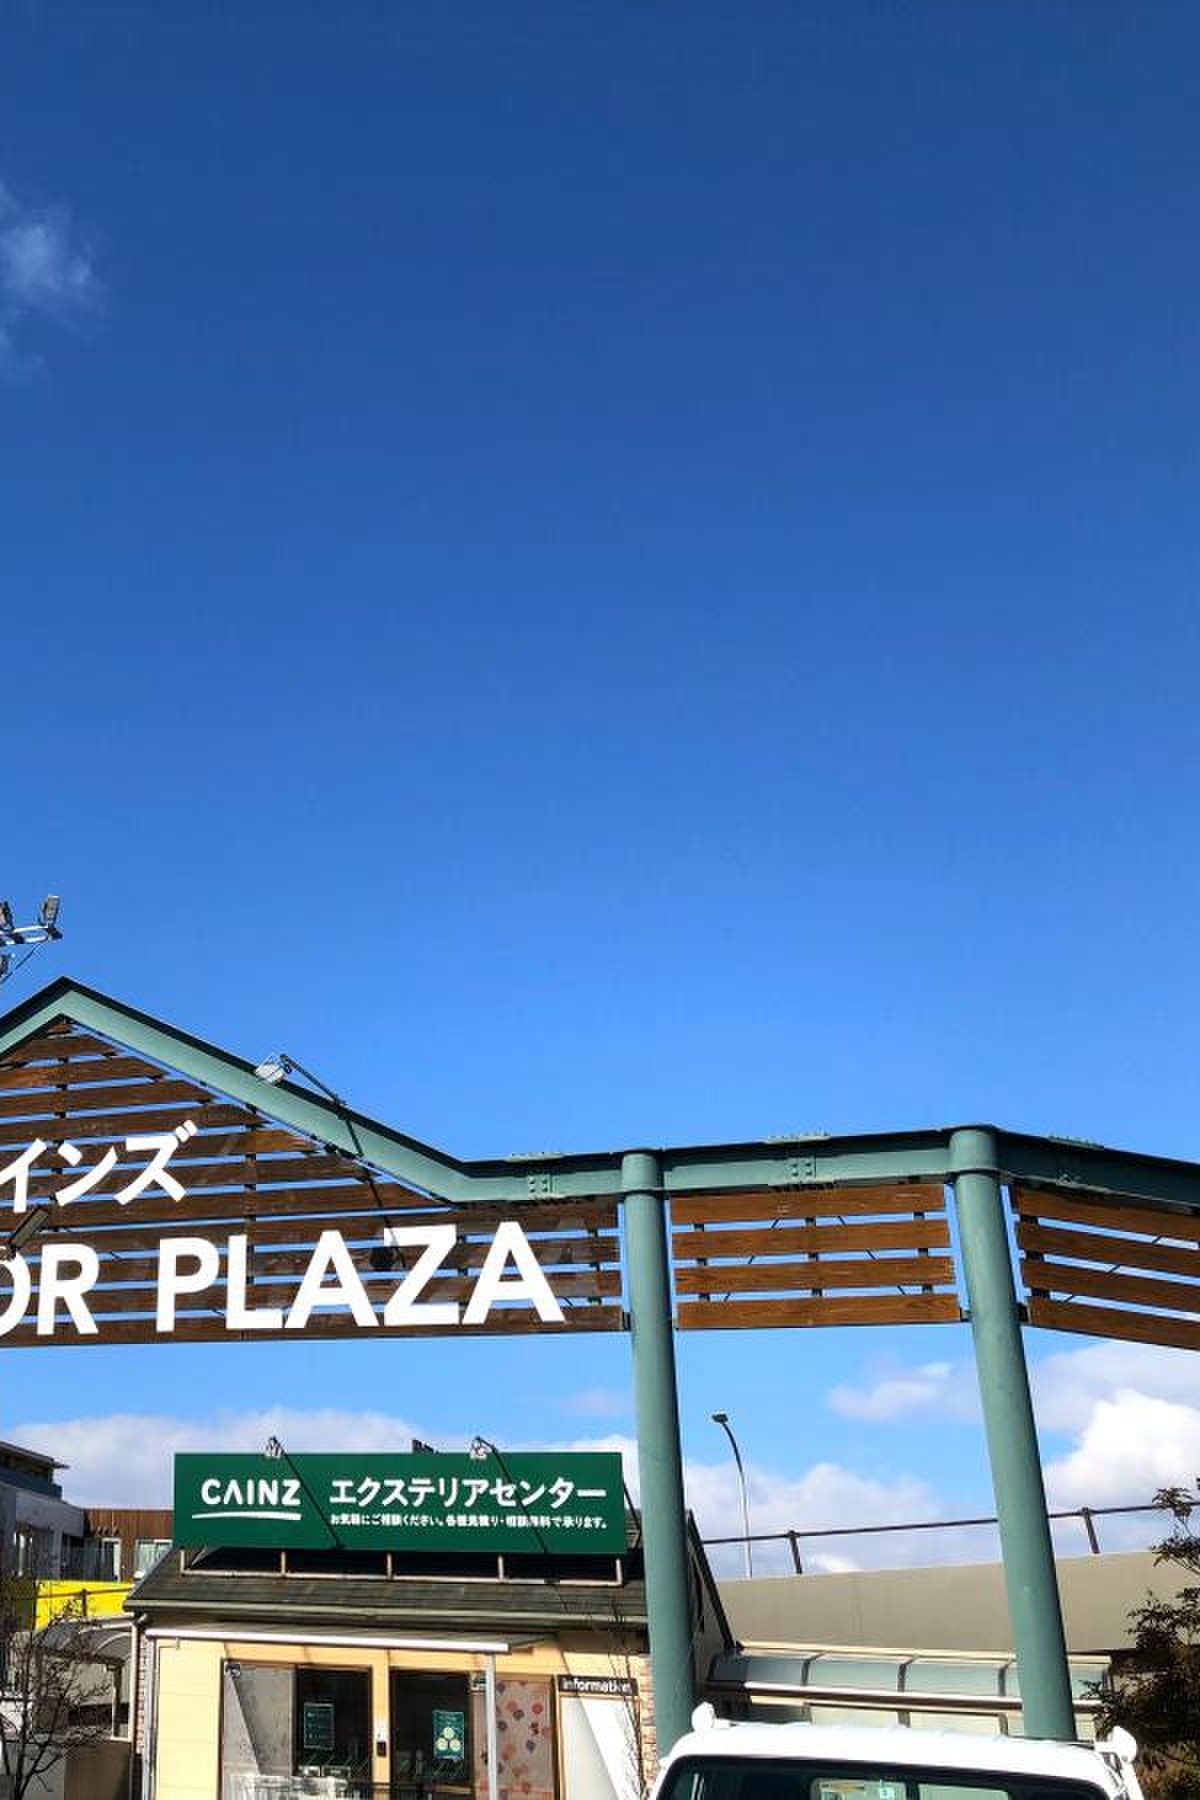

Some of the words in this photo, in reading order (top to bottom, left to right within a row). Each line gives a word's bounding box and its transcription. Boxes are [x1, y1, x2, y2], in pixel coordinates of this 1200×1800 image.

[156, 1221, 565, 1333] PLAZA
[200, 1478, 301, 1506] CAINZ
[329, 1477, 607, 1508] エクステリアセンター
